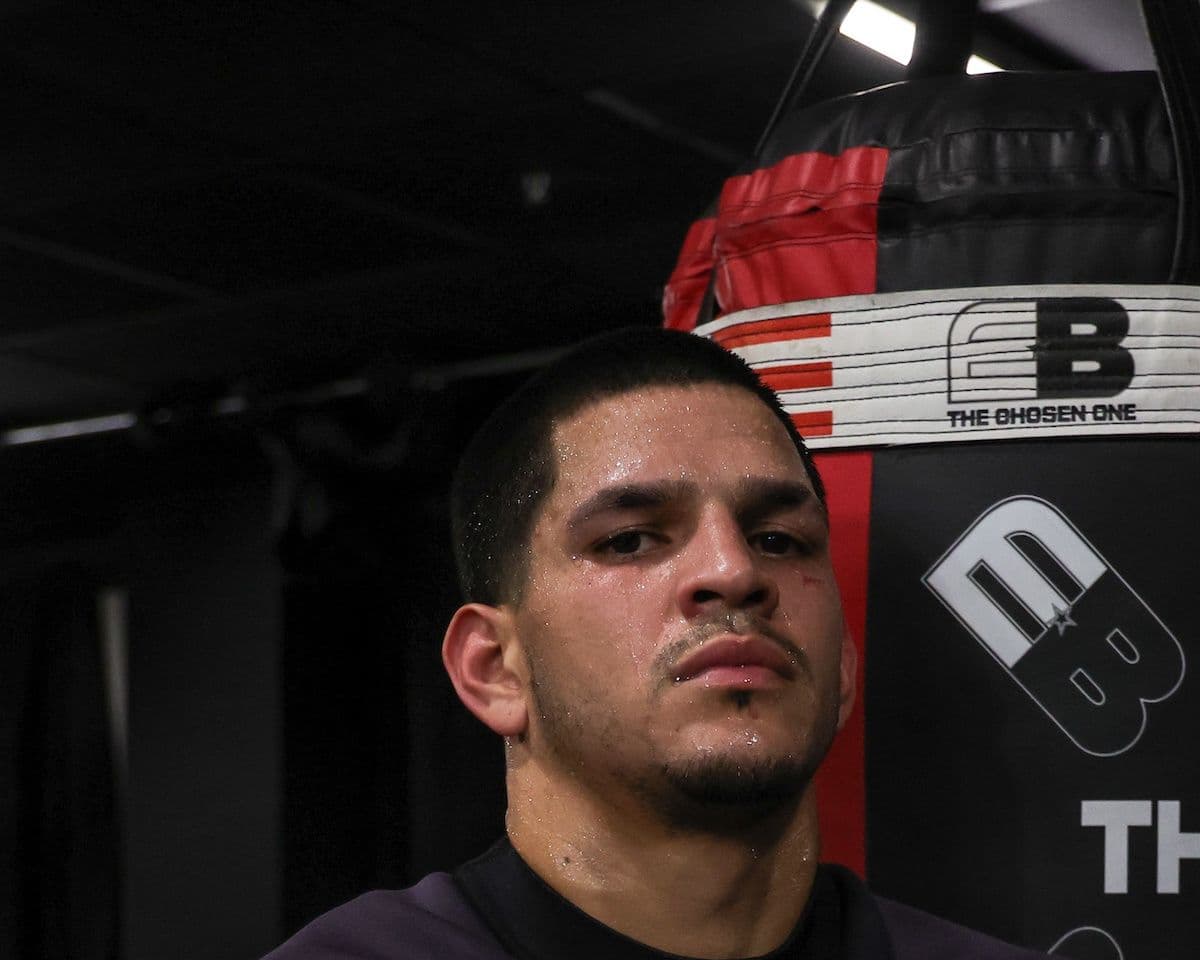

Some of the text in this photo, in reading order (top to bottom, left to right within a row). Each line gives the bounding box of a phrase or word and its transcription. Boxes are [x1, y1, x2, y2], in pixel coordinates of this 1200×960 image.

[947, 403, 1137, 428] THE CHOSEN ONE
